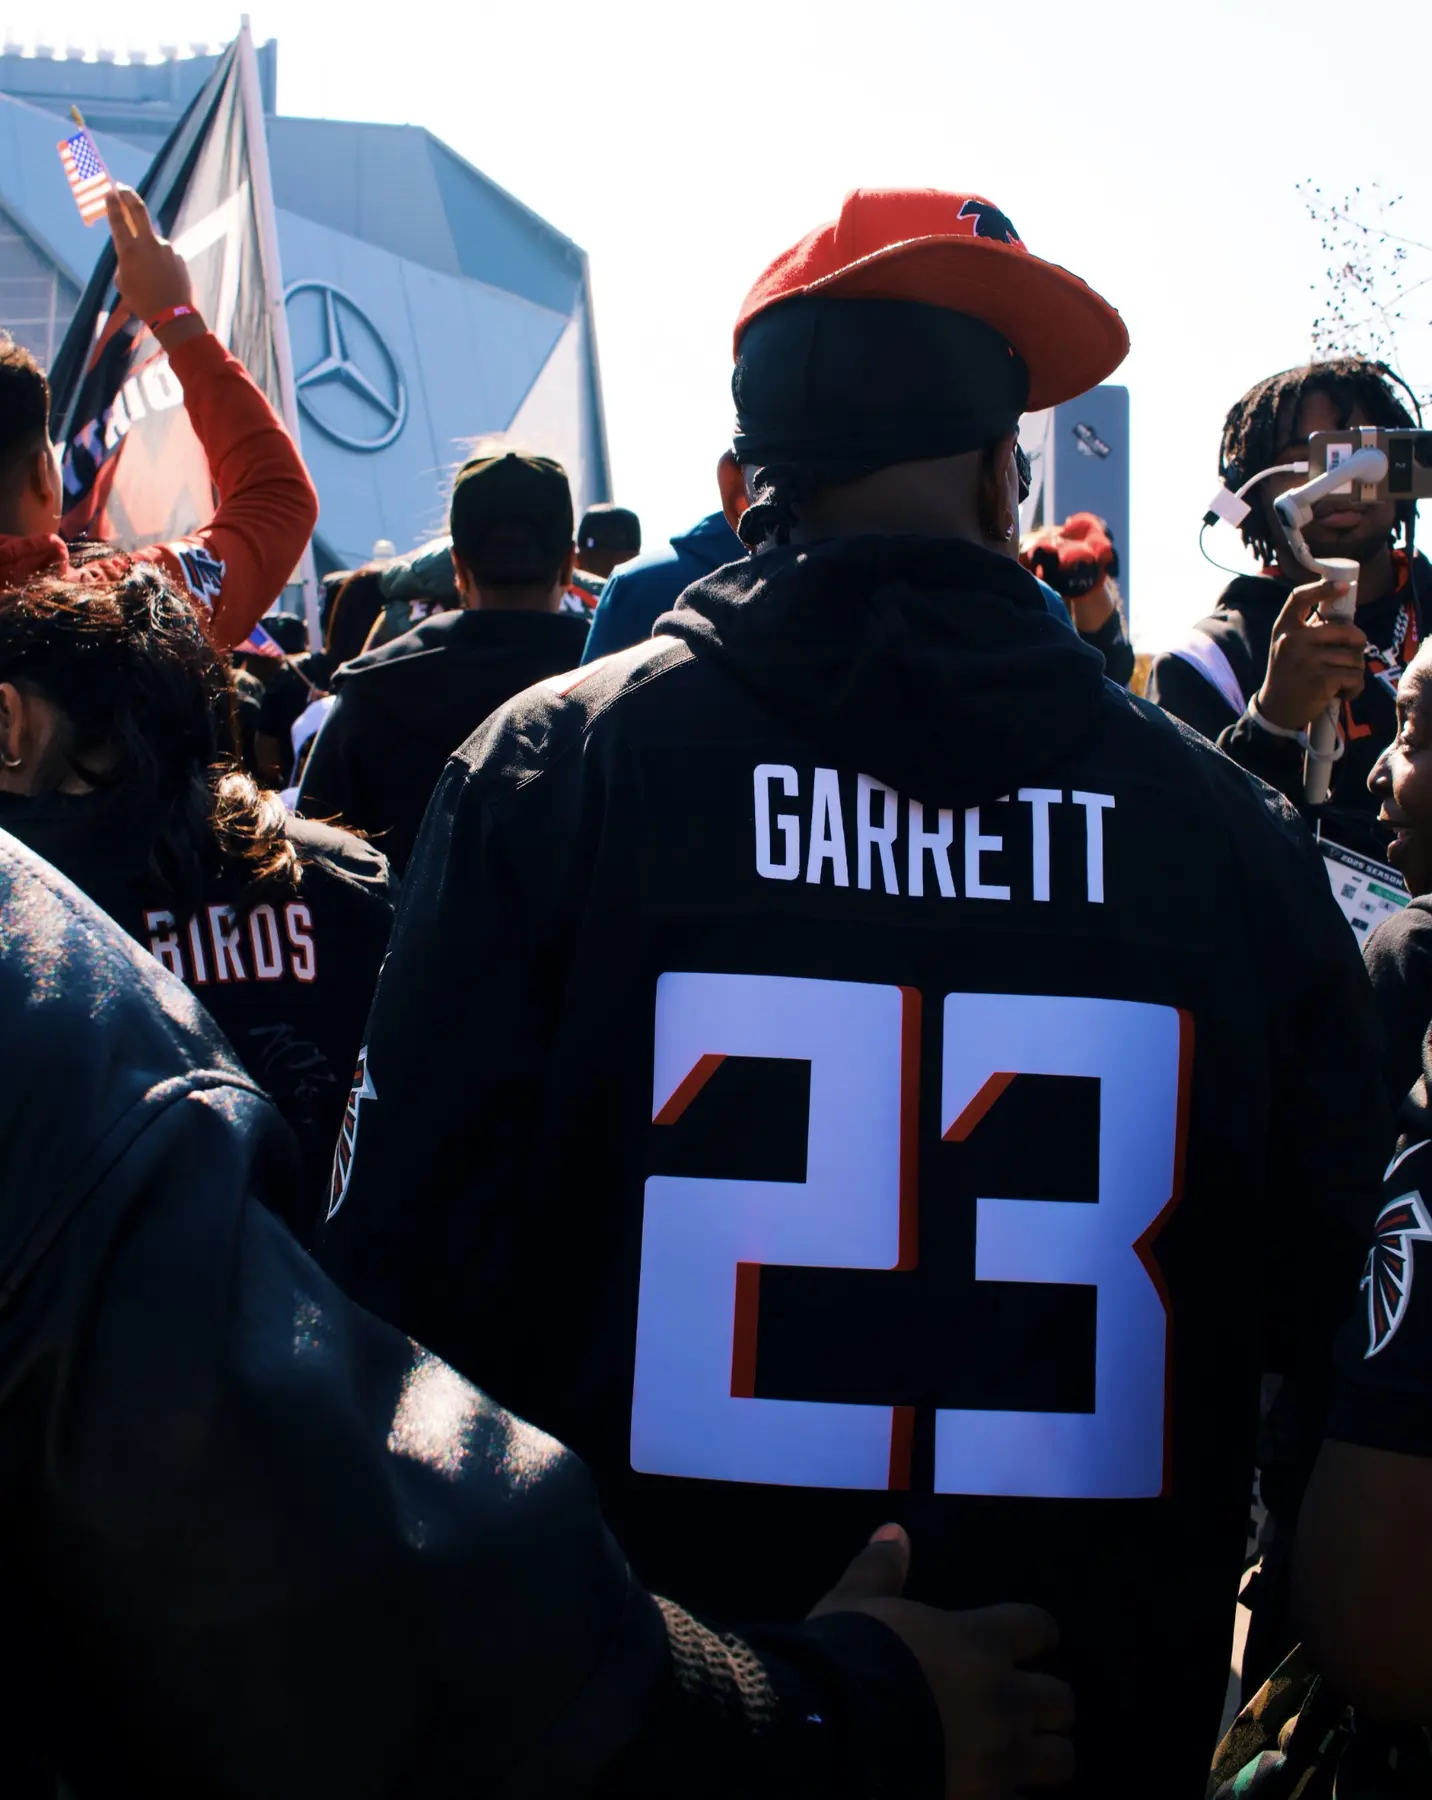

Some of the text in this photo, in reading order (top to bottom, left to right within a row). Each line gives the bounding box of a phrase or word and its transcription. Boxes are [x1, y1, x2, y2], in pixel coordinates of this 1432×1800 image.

[753, 763, 1115, 903] GARRETT
[1366, 865, 1403, 887] SEASON
[142, 901, 319, 985] BIRDS
[630, 971, 1195, 1499] 23
